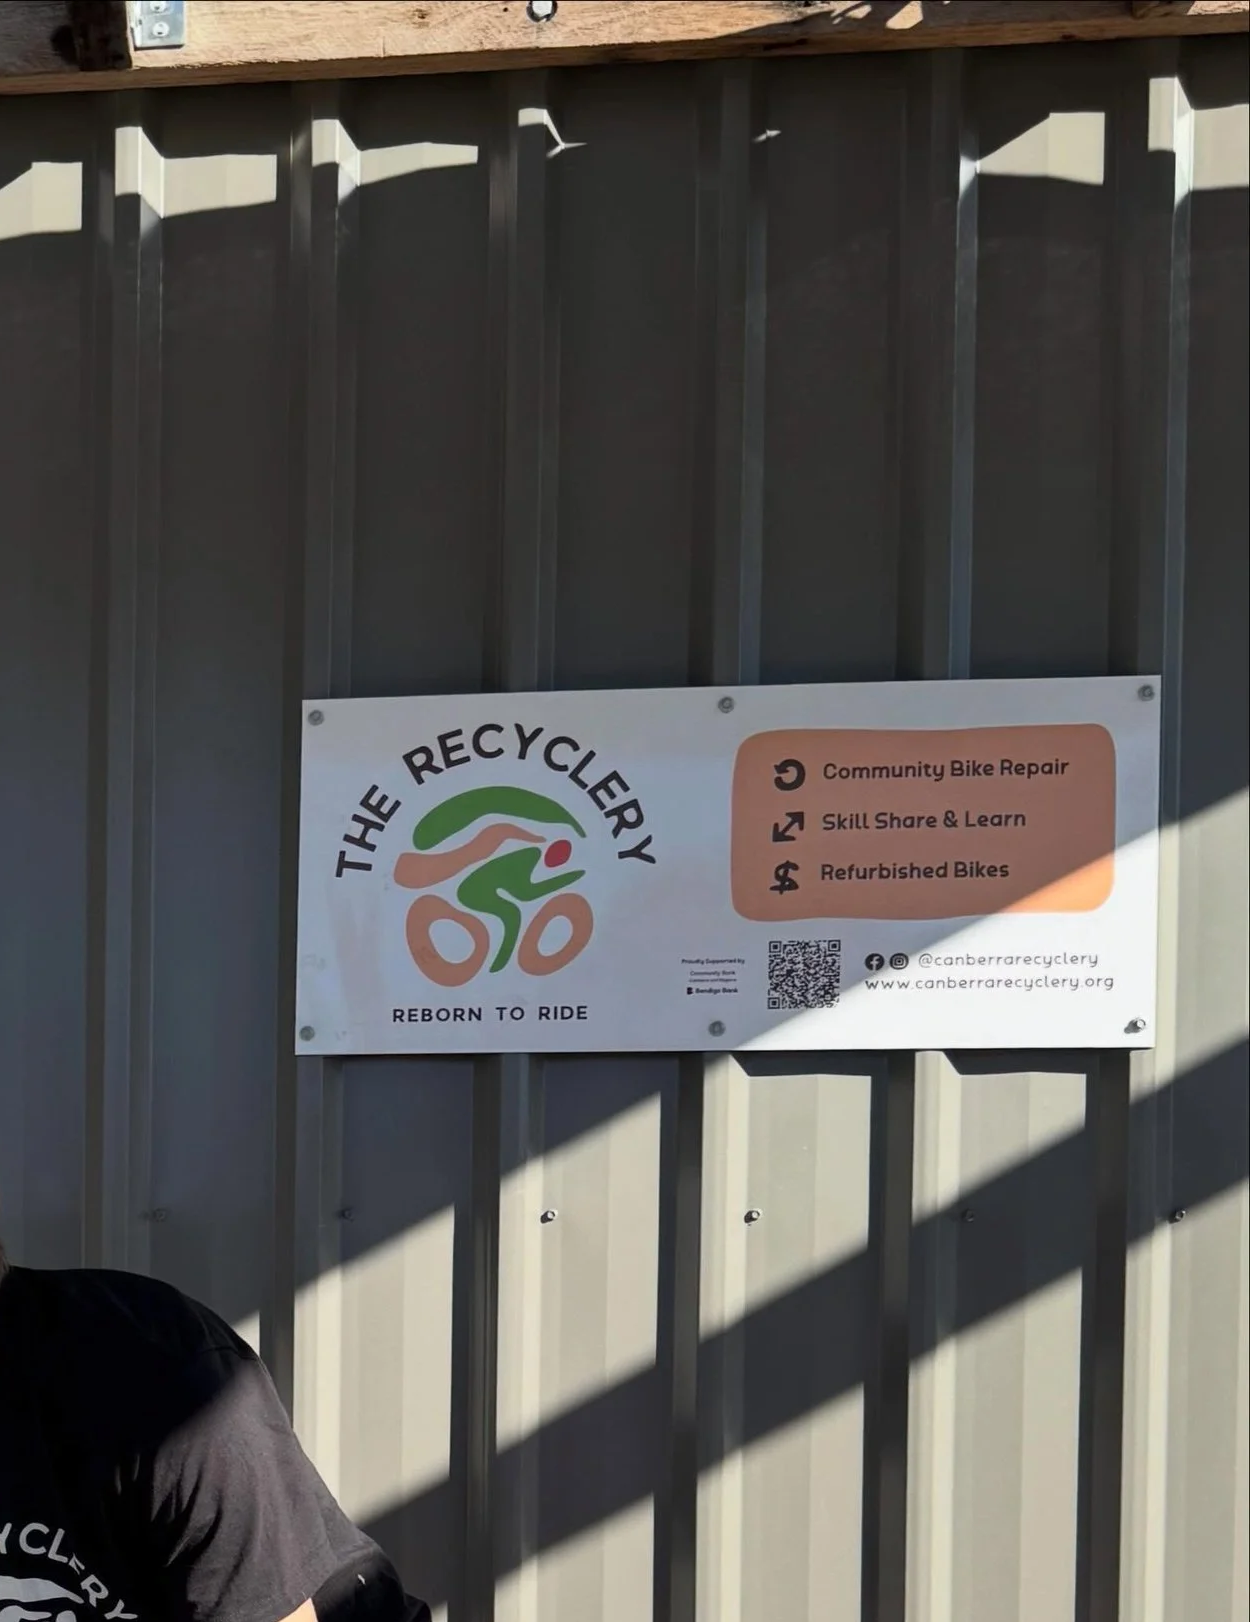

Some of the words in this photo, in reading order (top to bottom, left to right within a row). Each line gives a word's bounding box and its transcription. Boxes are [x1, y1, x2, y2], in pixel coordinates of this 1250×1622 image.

[823, 759, 945, 782] Community
[949, 758, 997, 778] Bike
[1000, 756, 1071, 779] Repair
[335, 784, 402, 880] THE
[402, 723, 658, 869] RECYCLERY
[821, 808, 868, 831] Skill
[875, 808, 938, 831] Share
[943, 808, 959, 829] &
[965, 808, 1027, 828] Learn
[820, 860, 948, 883] Refurbished
[953, 860, 1010, 881] Bikes
[918, 949, 1100, 972] @canberrarecyclery
[865, 972, 1115, 993] www.canberrarecyclery.org
[392, 1005, 484, 1024] REBORN
[495, 1005, 525, 1022] TO
[538, 1003, 588, 1022] RIDE
